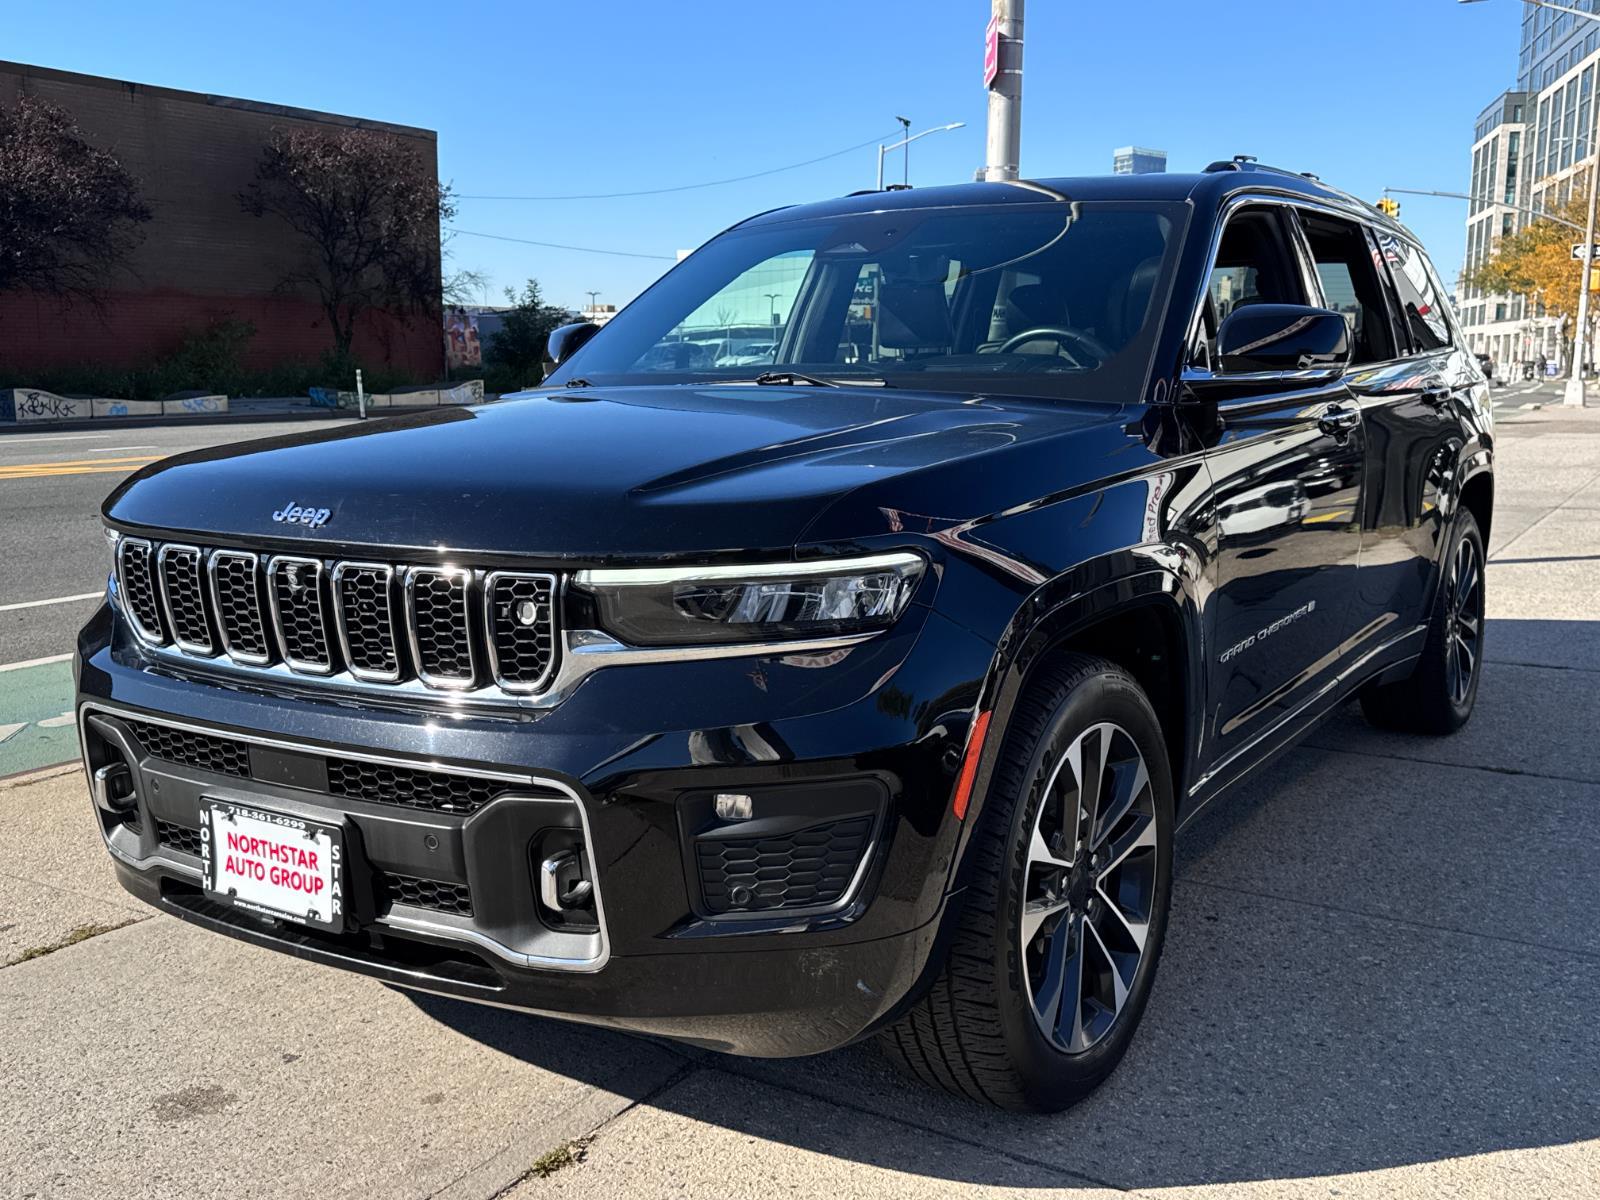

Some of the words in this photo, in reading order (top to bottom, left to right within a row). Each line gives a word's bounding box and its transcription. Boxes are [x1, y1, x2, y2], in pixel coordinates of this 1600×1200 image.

[272, 501, 331, 528] Jeep
[1220, 635, 1256, 663] GRAND
[1257, 605, 1308, 640] CHEROKEE
[228, 806, 306, 830] 718-361-6299
[200, 809, 212, 891] NORTH
[227, 831, 320, 872] NORTHSTAR
[225, 854, 266, 882] AUTO
[269, 865, 324, 896] GROUP
[331, 844, 342, 916] STAR
